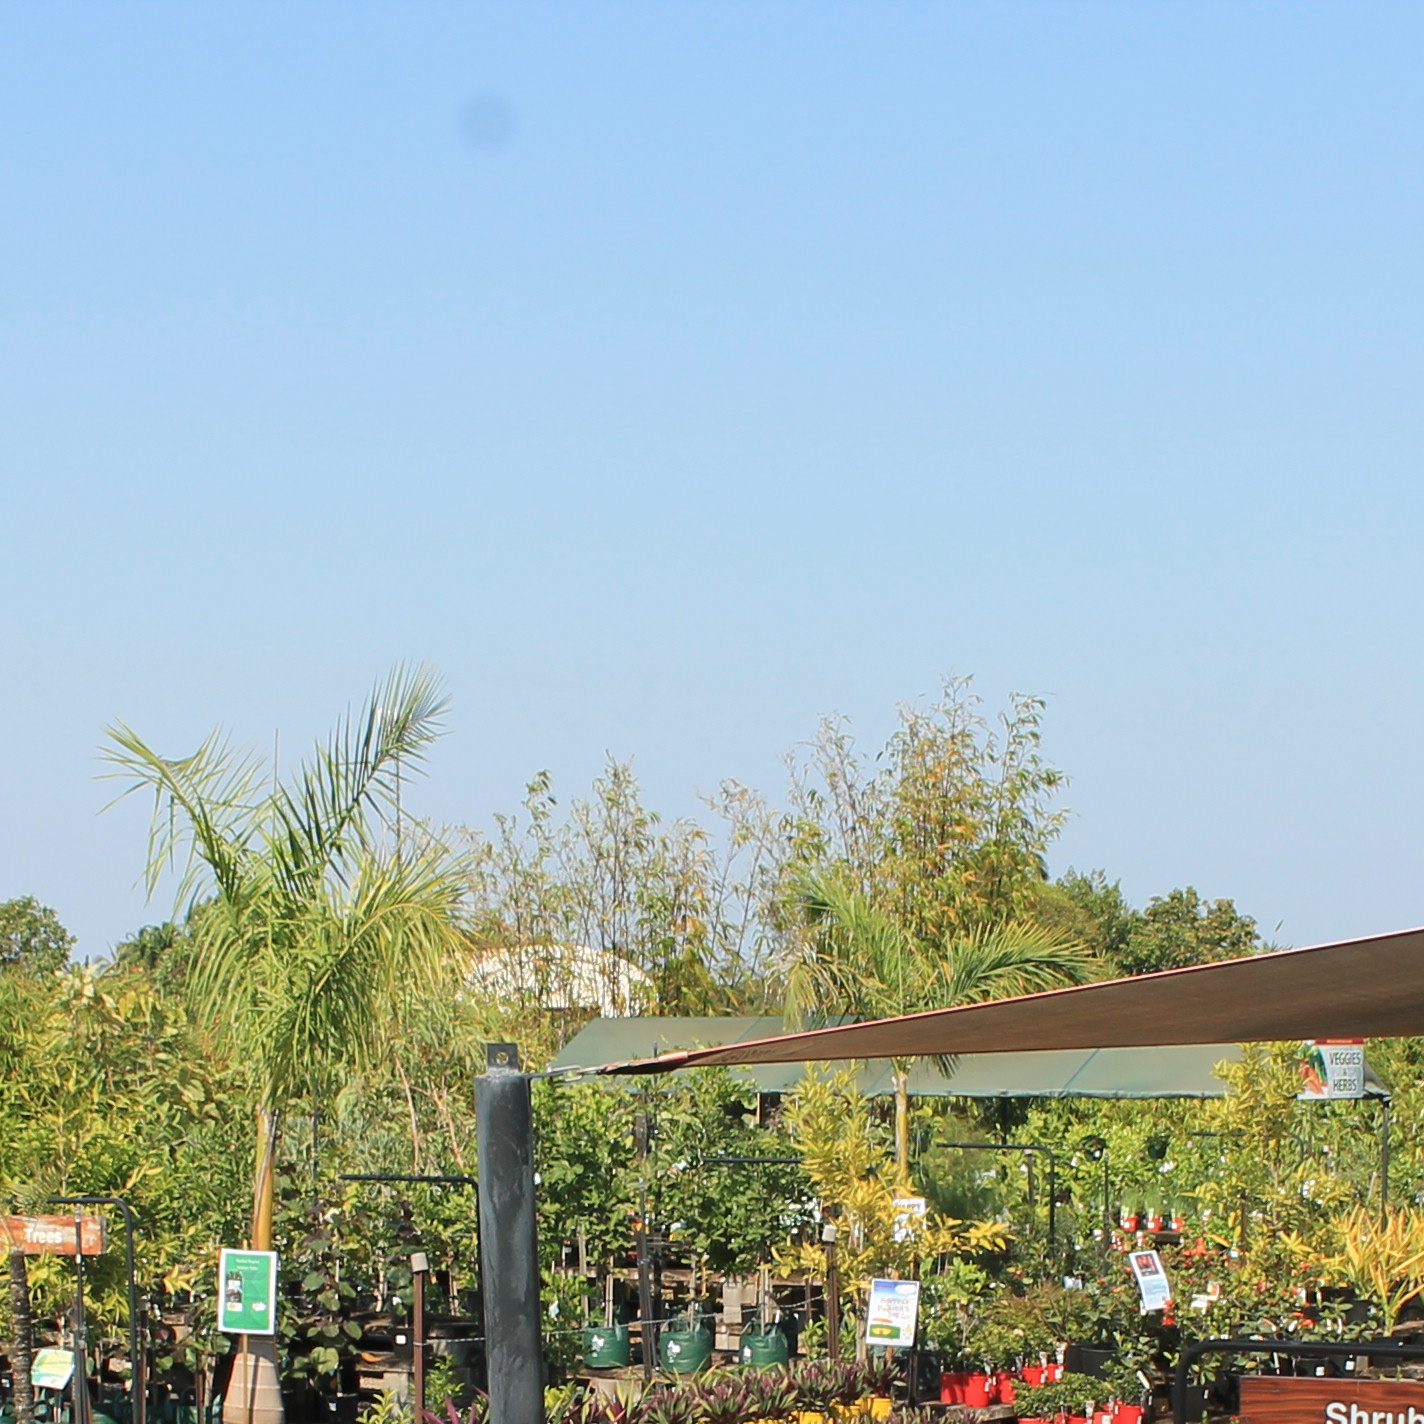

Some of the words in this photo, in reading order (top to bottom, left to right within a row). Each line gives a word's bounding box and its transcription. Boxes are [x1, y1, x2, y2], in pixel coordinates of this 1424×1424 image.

[1329, 1052, 1361, 1066] VEGGIES
[1333, 1078, 1357, 1092] HERBS
[24, 1227, 63, 1244] Trees
